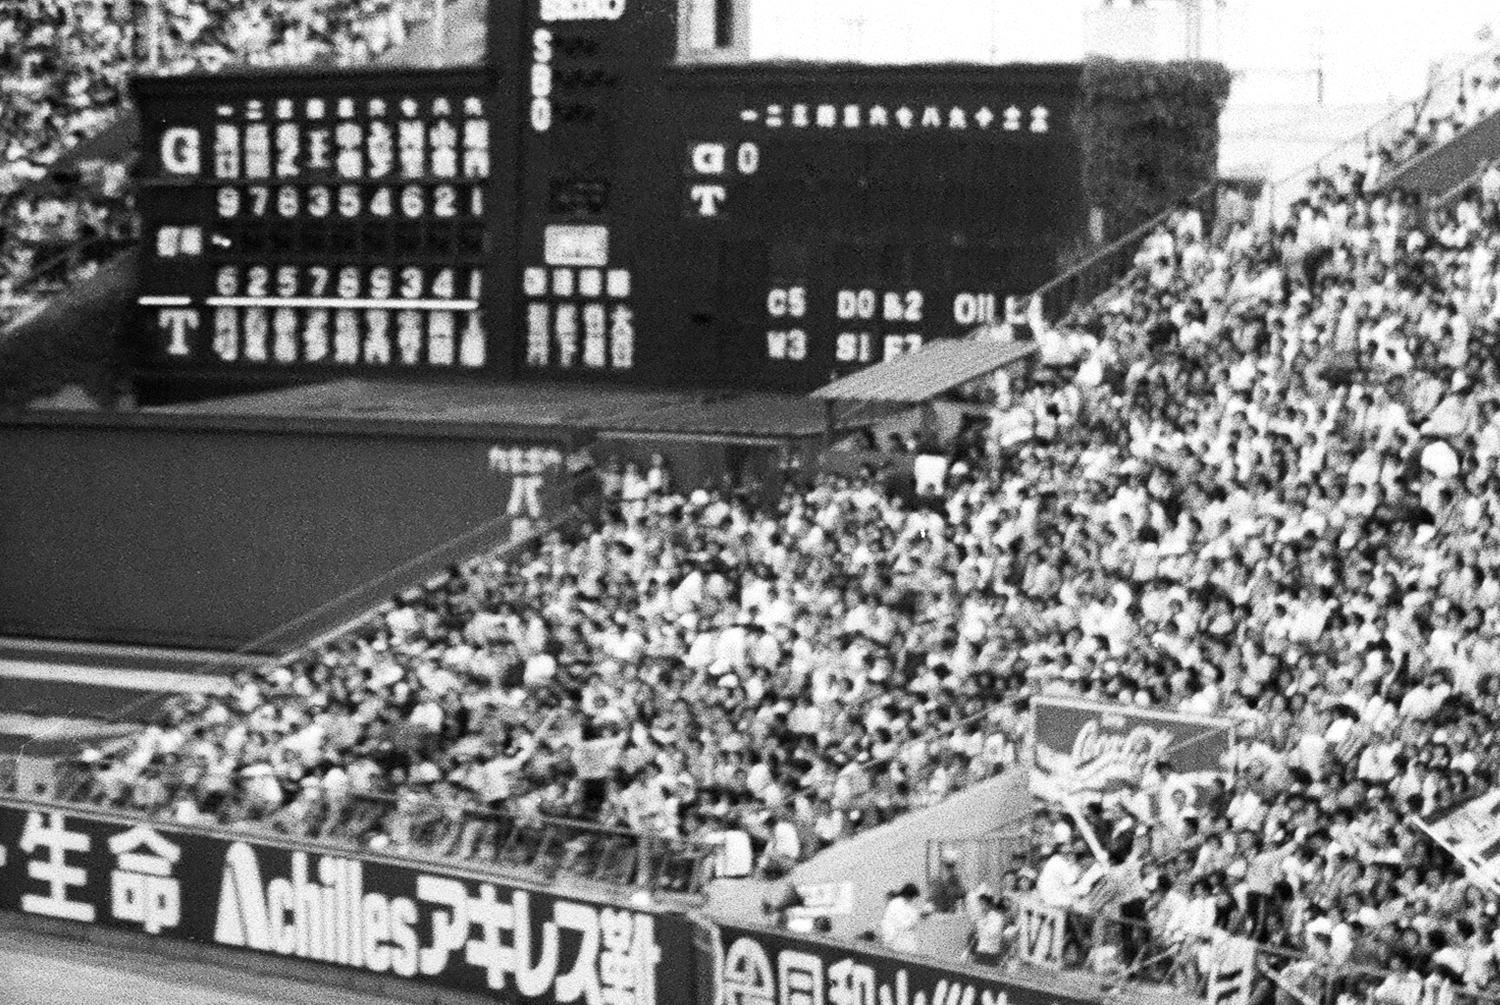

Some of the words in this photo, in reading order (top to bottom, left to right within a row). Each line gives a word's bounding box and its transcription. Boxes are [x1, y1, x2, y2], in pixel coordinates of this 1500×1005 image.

[162, 128, 201, 175] G
[690, 184, 726, 217] T
[159, 309, 199, 355] T
[0, 811, 180, 933] 生命
[213, 840, 419, 976] Achilles
